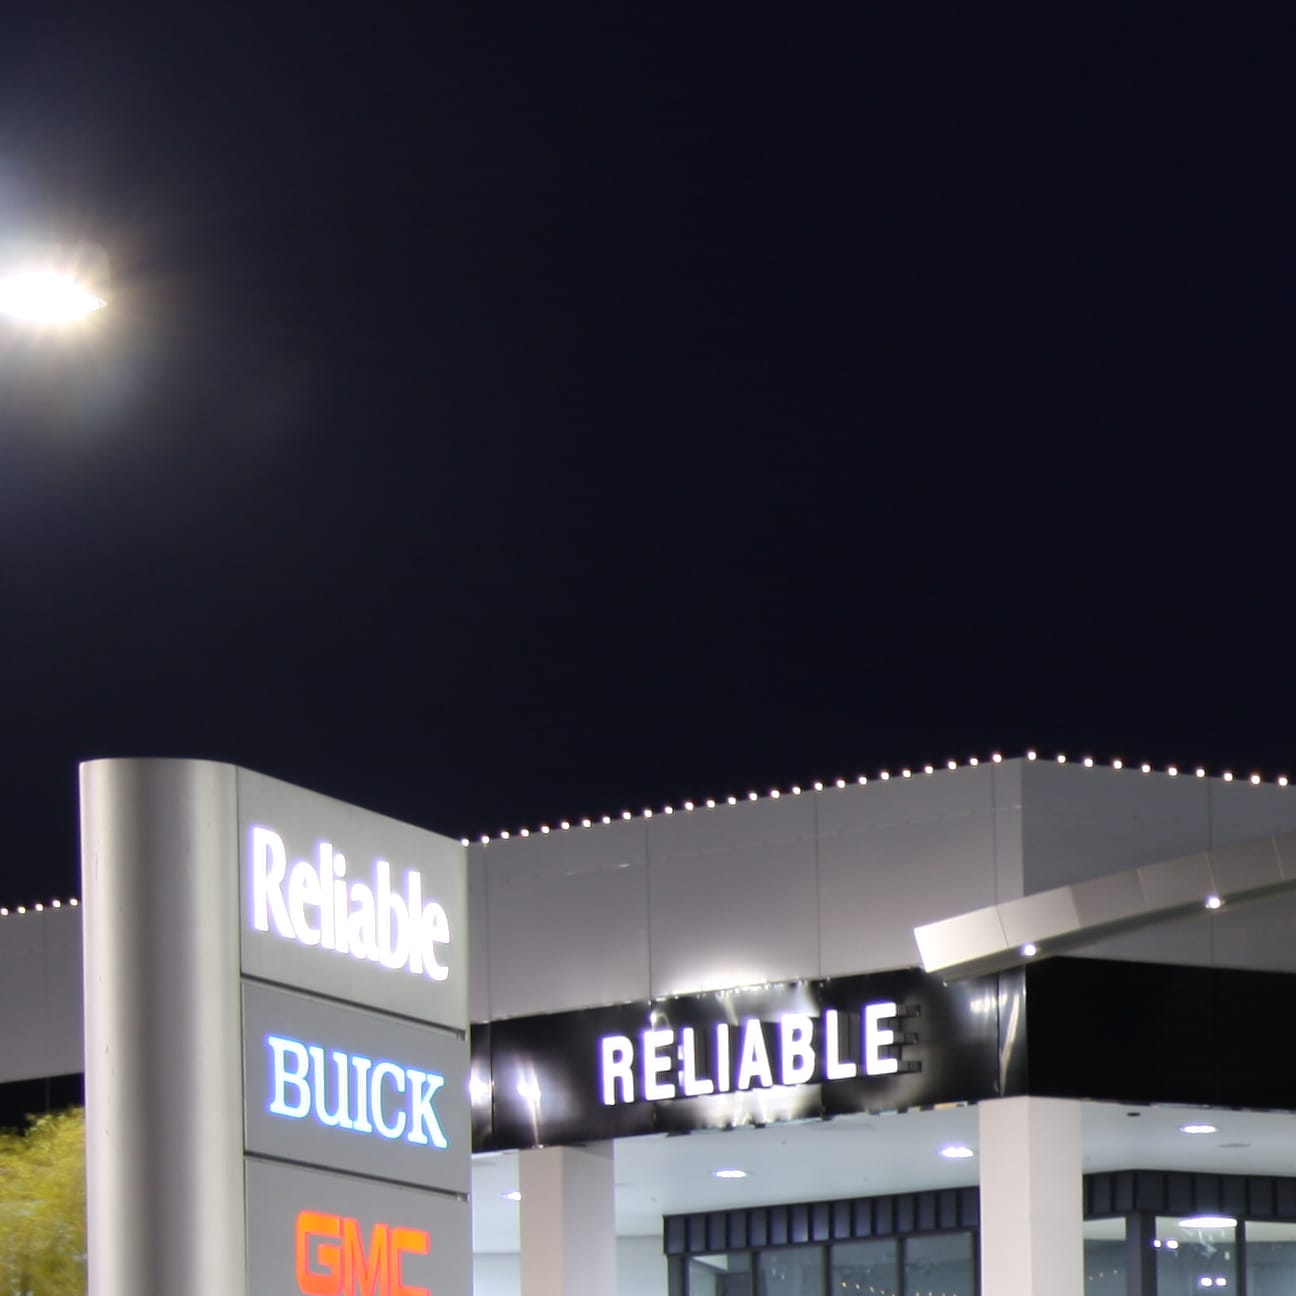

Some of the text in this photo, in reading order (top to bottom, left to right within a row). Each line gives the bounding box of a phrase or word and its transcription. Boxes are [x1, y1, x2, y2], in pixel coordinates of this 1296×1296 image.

[252, 826, 450, 981] Reliable
[267, 1035, 448, 1149] BUICK
[599, 1002, 898, 1106] RELIABLE
